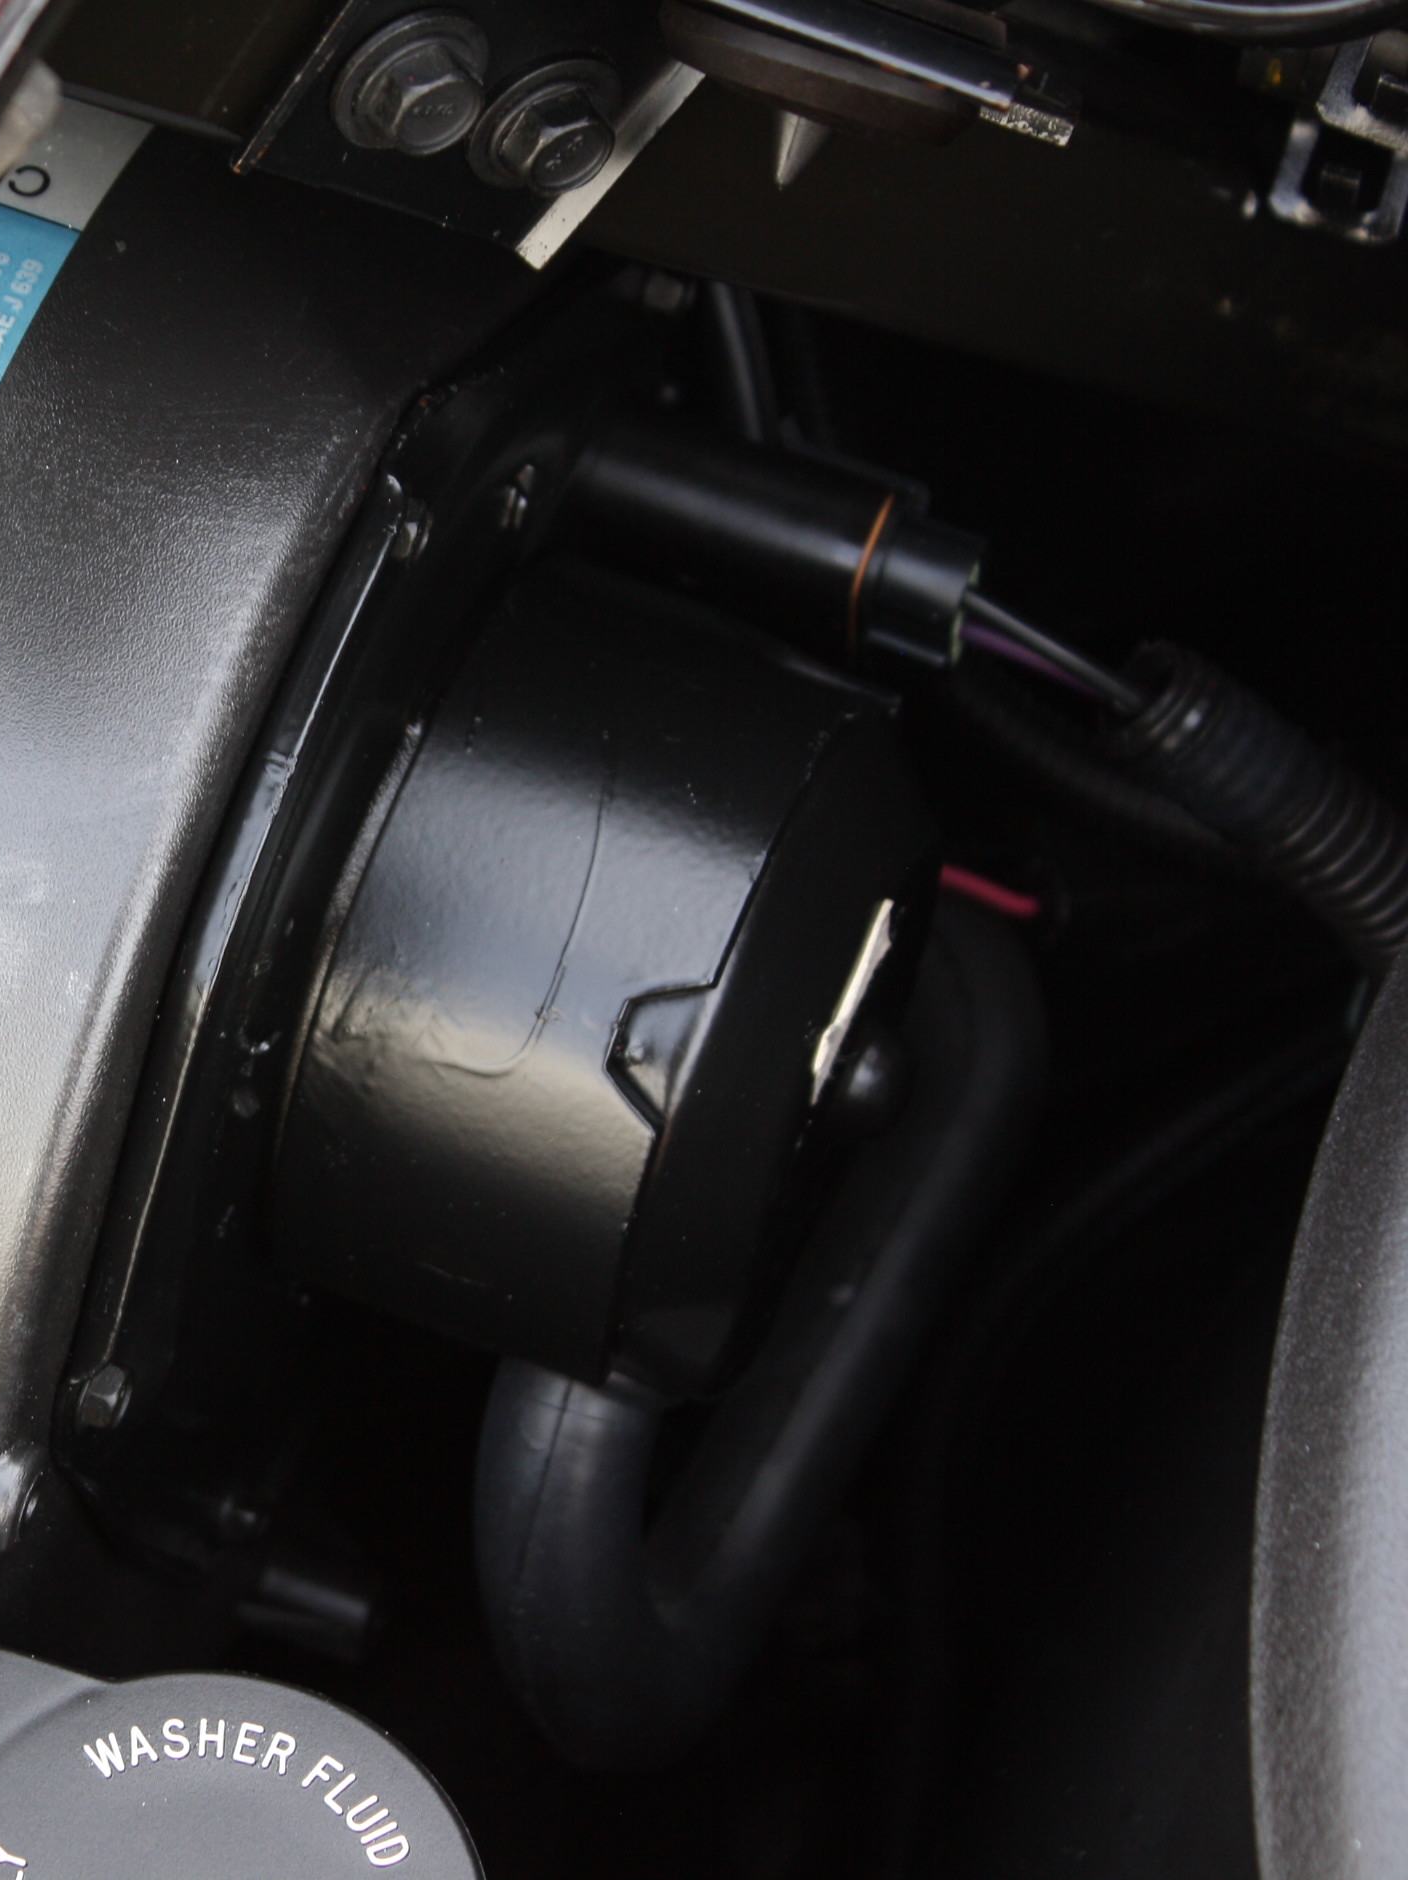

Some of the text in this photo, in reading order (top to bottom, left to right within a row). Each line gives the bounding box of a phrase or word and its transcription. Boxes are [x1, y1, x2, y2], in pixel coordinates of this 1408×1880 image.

[10, 259, 43, 295] 639
[3, 295, 24, 313] J
[82, 1718, 411, 1868] WASHER FLUID
